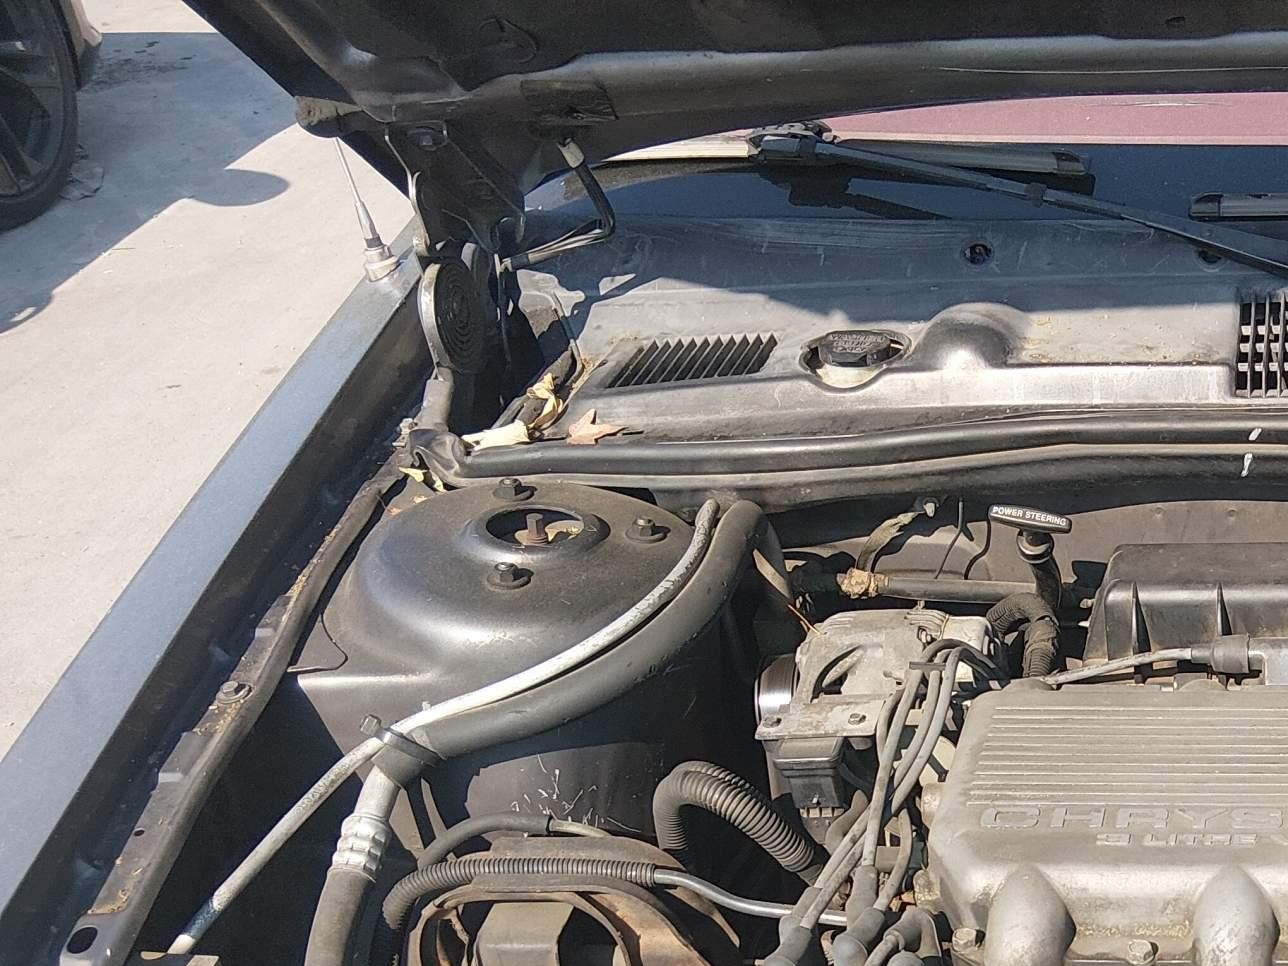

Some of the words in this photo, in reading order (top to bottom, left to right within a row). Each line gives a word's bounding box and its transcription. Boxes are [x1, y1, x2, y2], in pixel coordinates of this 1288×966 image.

[992, 506, 1023, 517] POWER
[1025, 511, 1067, 526] STEERING
[1142, 832, 1258, 847] LITRE
